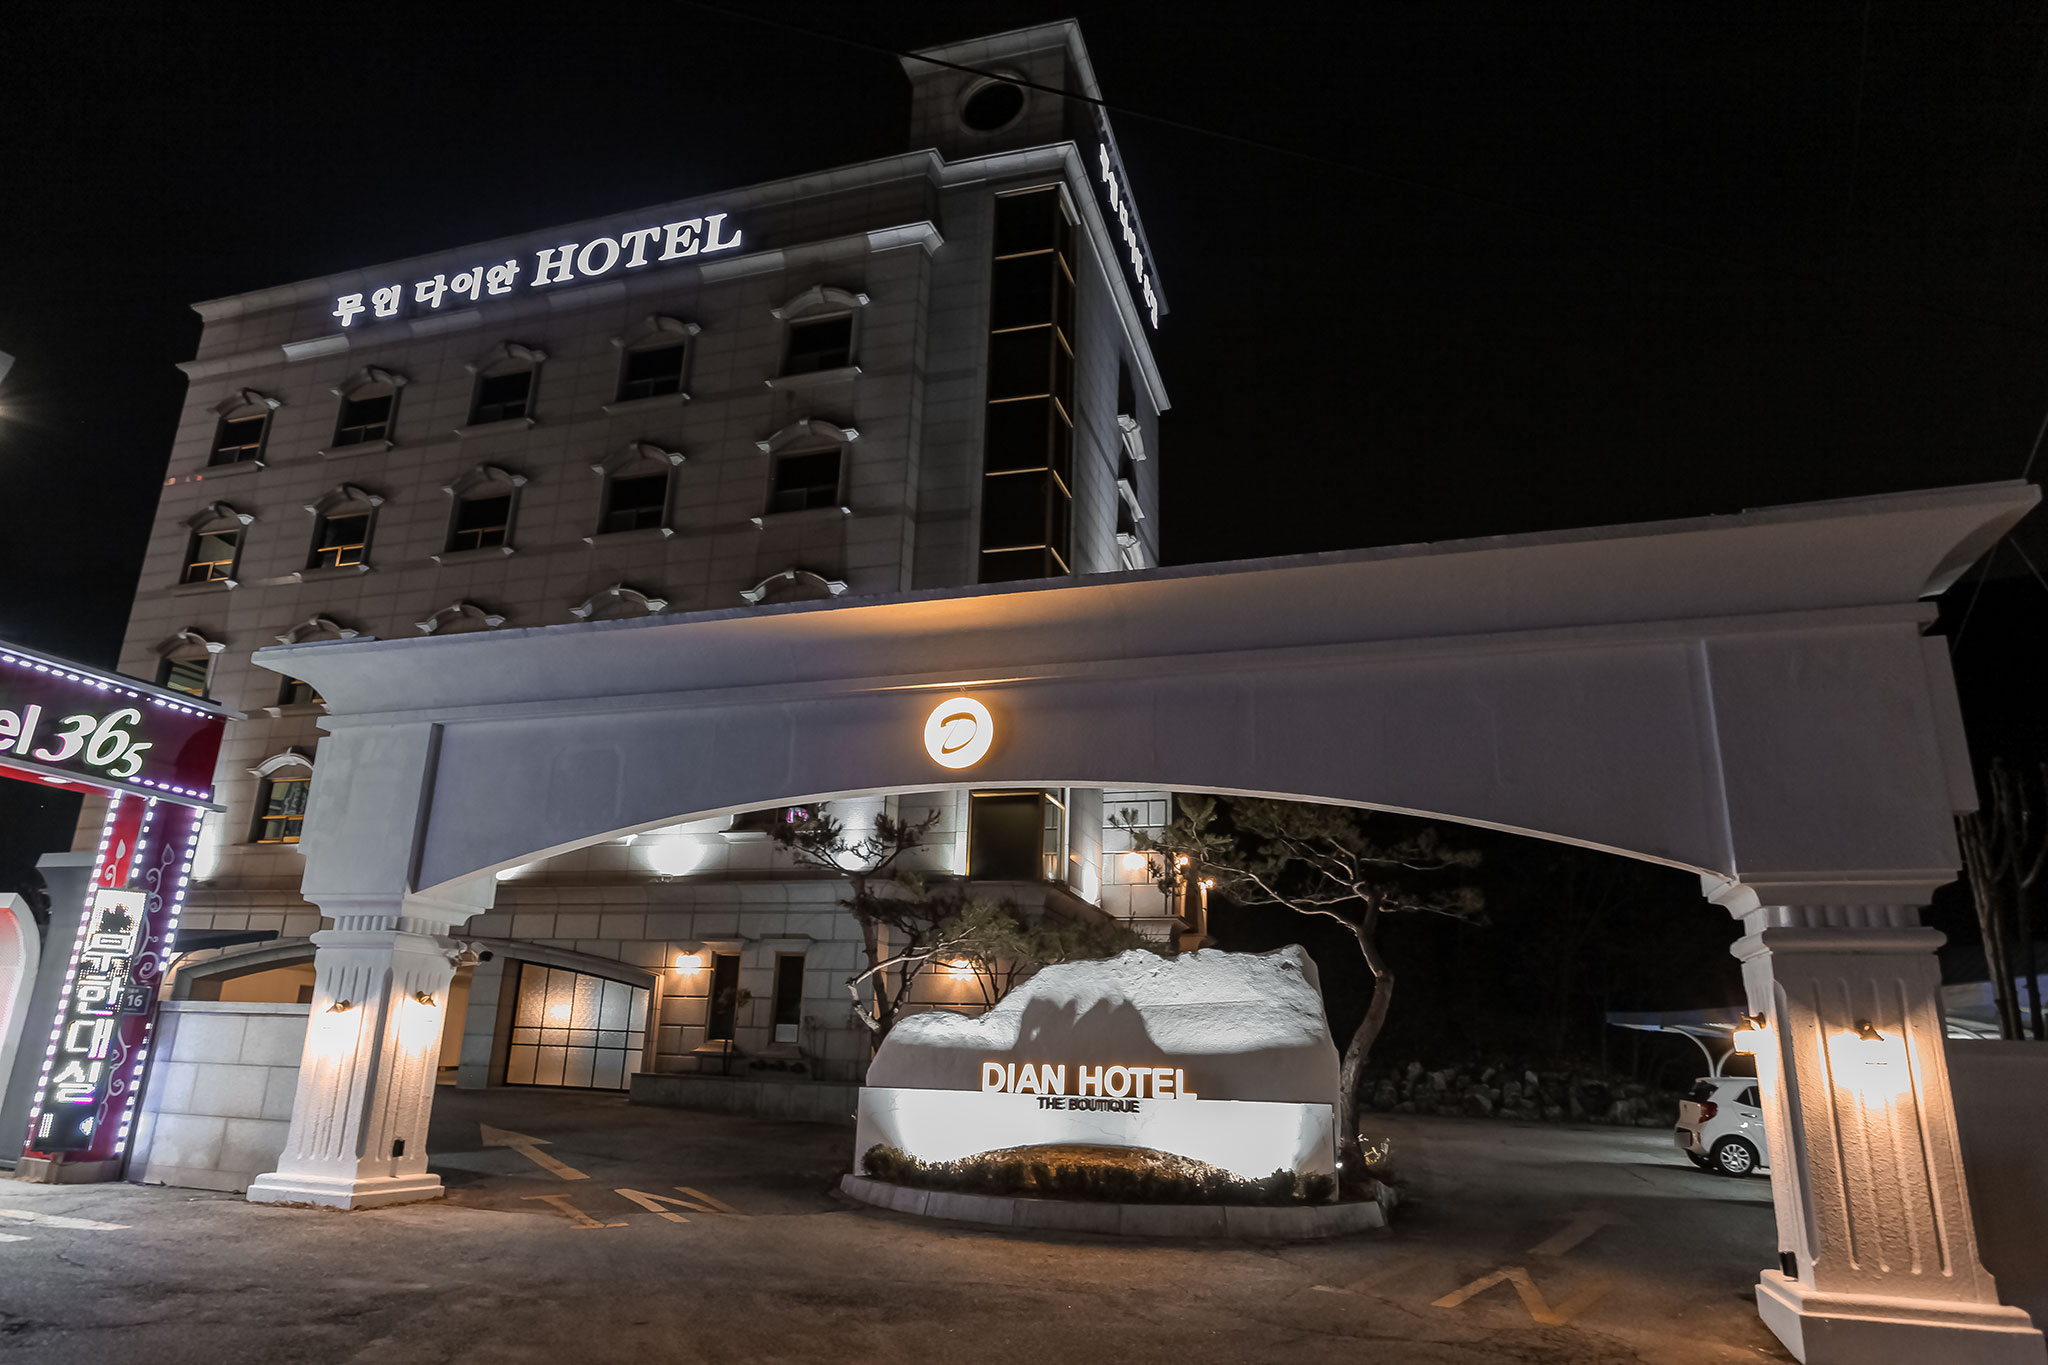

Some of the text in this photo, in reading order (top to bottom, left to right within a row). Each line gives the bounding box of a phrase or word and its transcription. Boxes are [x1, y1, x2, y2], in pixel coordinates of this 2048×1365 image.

[333, 213, 741, 326] 무인 다이안 HOTEL
[34, 708, 152, 777] 365
[127, 994, 143, 1007] 16
[982, 1062, 1198, 1100] DIAN HOTEL
[1036, 1097, 1141, 1113] THE BOUTIQUE
[520, 1187, 742, 1229] IN
